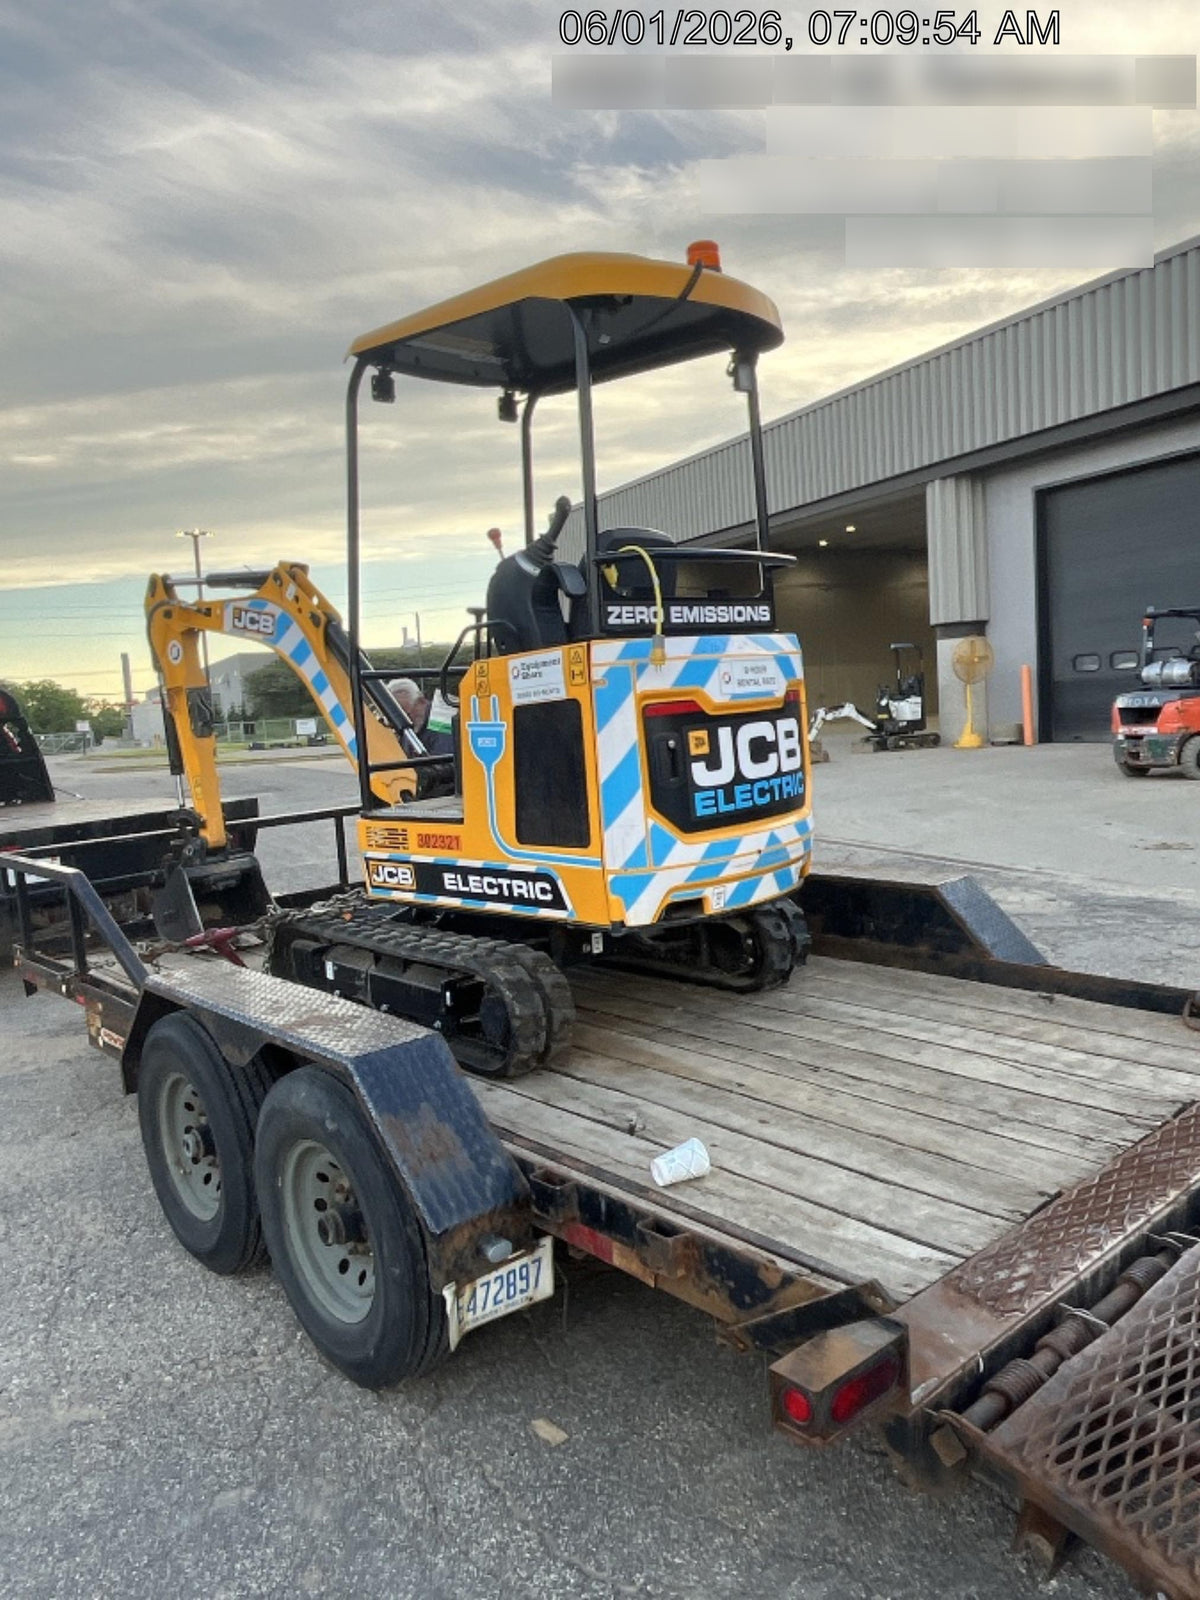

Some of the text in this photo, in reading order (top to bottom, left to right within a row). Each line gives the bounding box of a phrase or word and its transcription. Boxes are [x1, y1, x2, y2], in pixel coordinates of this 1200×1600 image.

[234, 611, 273, 633] JCB
[607, 605, 771, 624] ZERO EMISSIONS
[691, 718, 801, 787] JCB
[694, 771, 804, 817] ELECTRIC
[417, 833, 460, 850] 302321
[373, 865, 553, 900] JCB ELECTRIC
